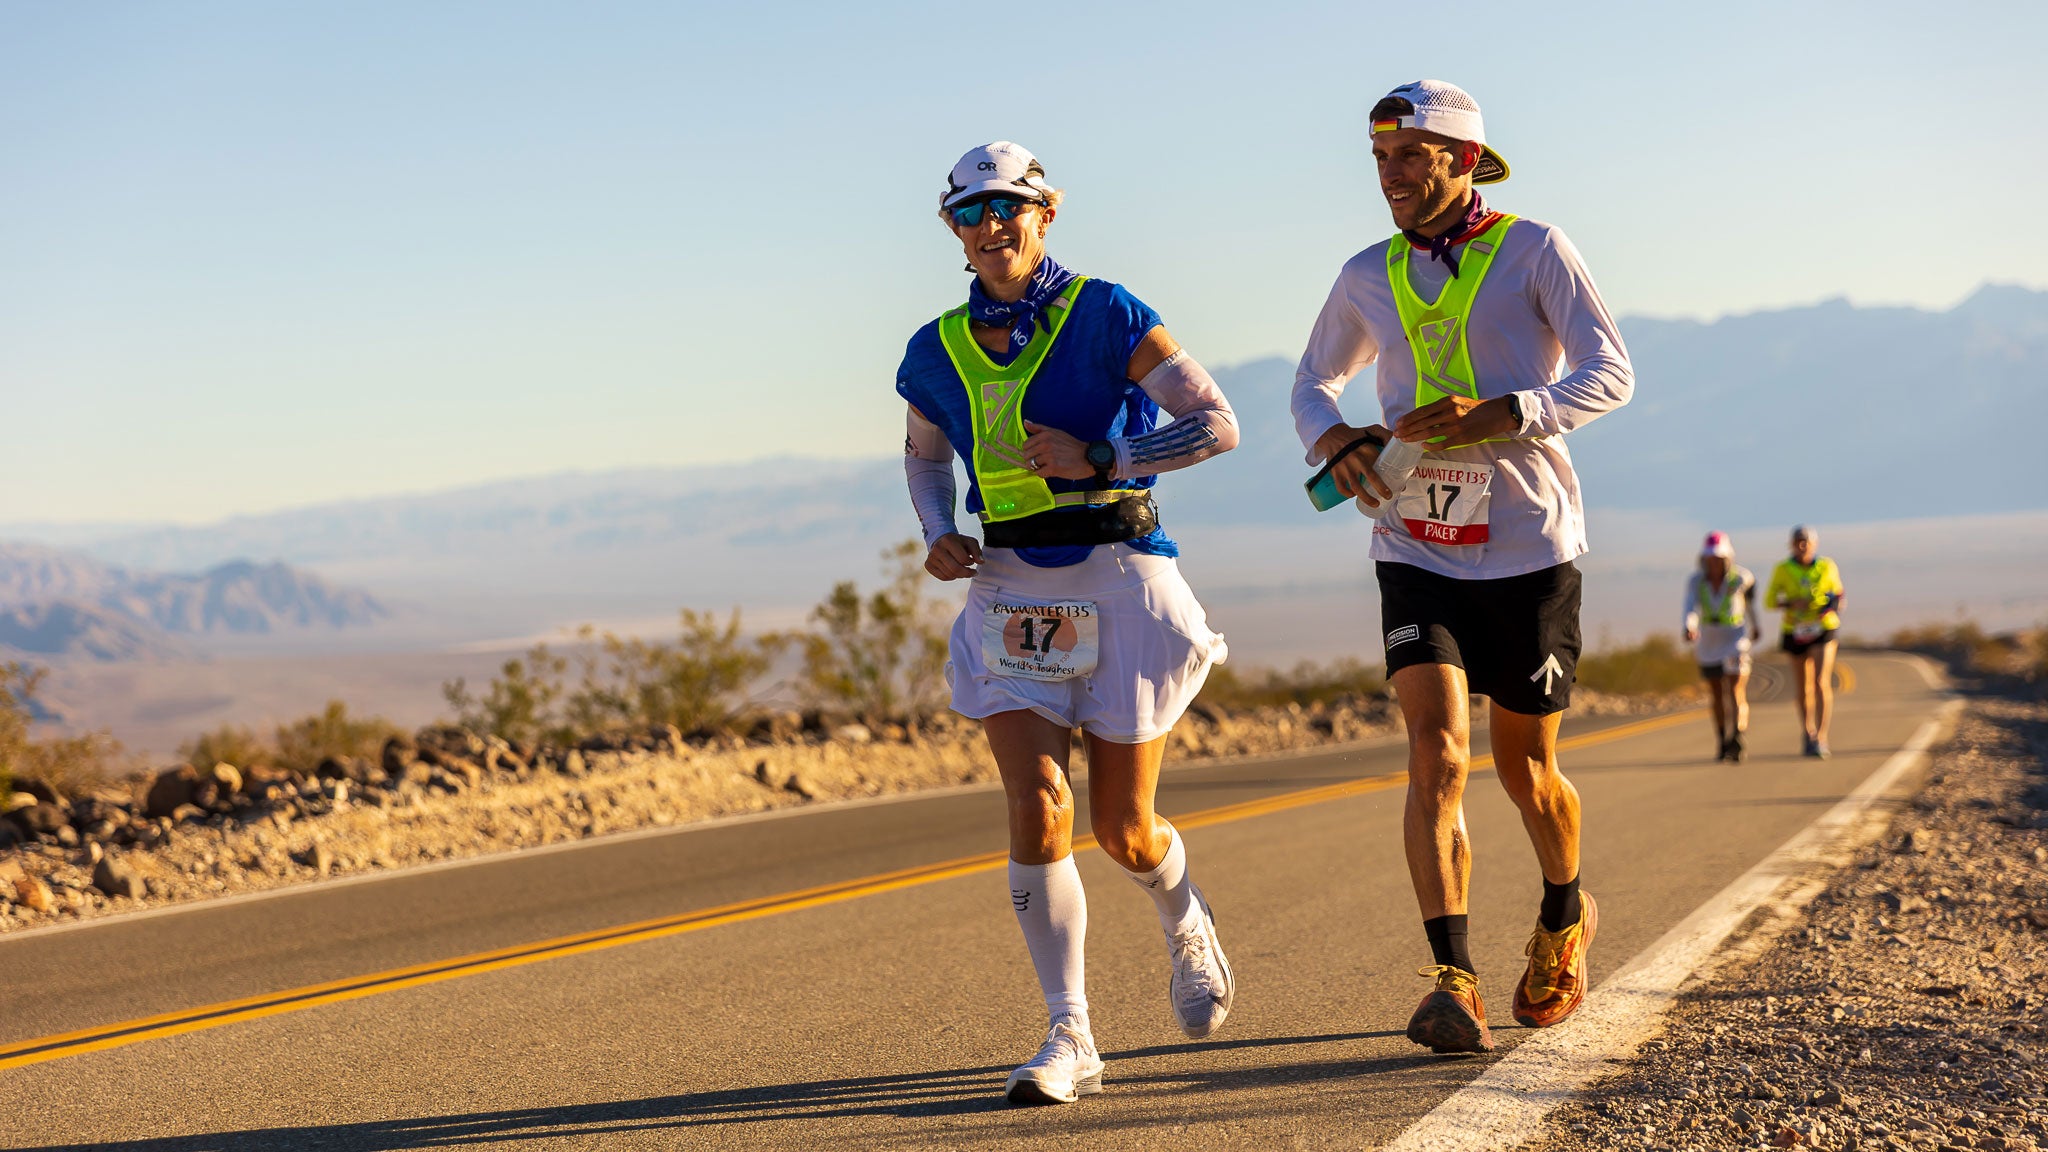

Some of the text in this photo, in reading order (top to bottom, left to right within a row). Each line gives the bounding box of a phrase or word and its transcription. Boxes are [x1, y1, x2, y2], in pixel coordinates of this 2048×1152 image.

[977, 161, 997, 171] OR
[1467, 472, 1488, 484] 135
[1427, 483, 1461, 521] 17
[1425, 523, 1457, 540] PACER
[1066, 605, 1090, 617] 135
[1020, 618, 1061, 653] 17
[1000, 658, 1033, 672] World's
[1036, 662, 1075, 677] Toughest
